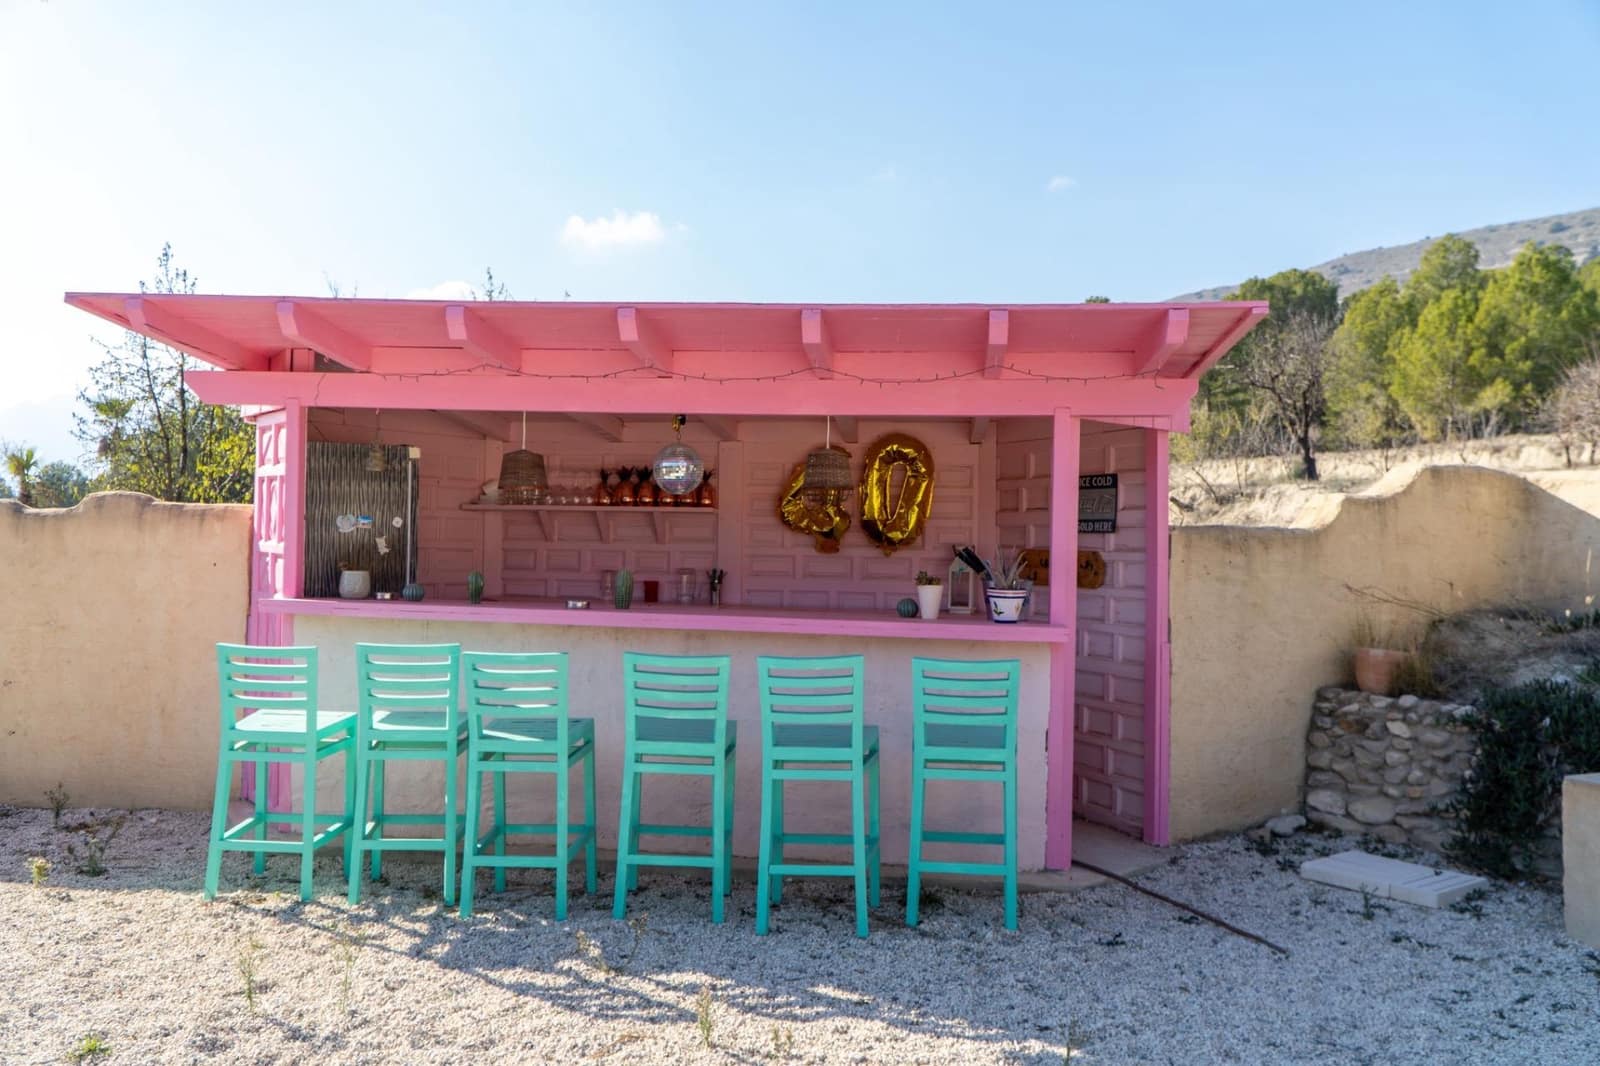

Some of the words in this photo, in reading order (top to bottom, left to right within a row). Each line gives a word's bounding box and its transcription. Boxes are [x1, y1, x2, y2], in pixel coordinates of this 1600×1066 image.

[1092, 476, 1113, 486] COLD
[1079, 521, 1094, 531] OLD
[1094, 521, 1113, 531] HERE
